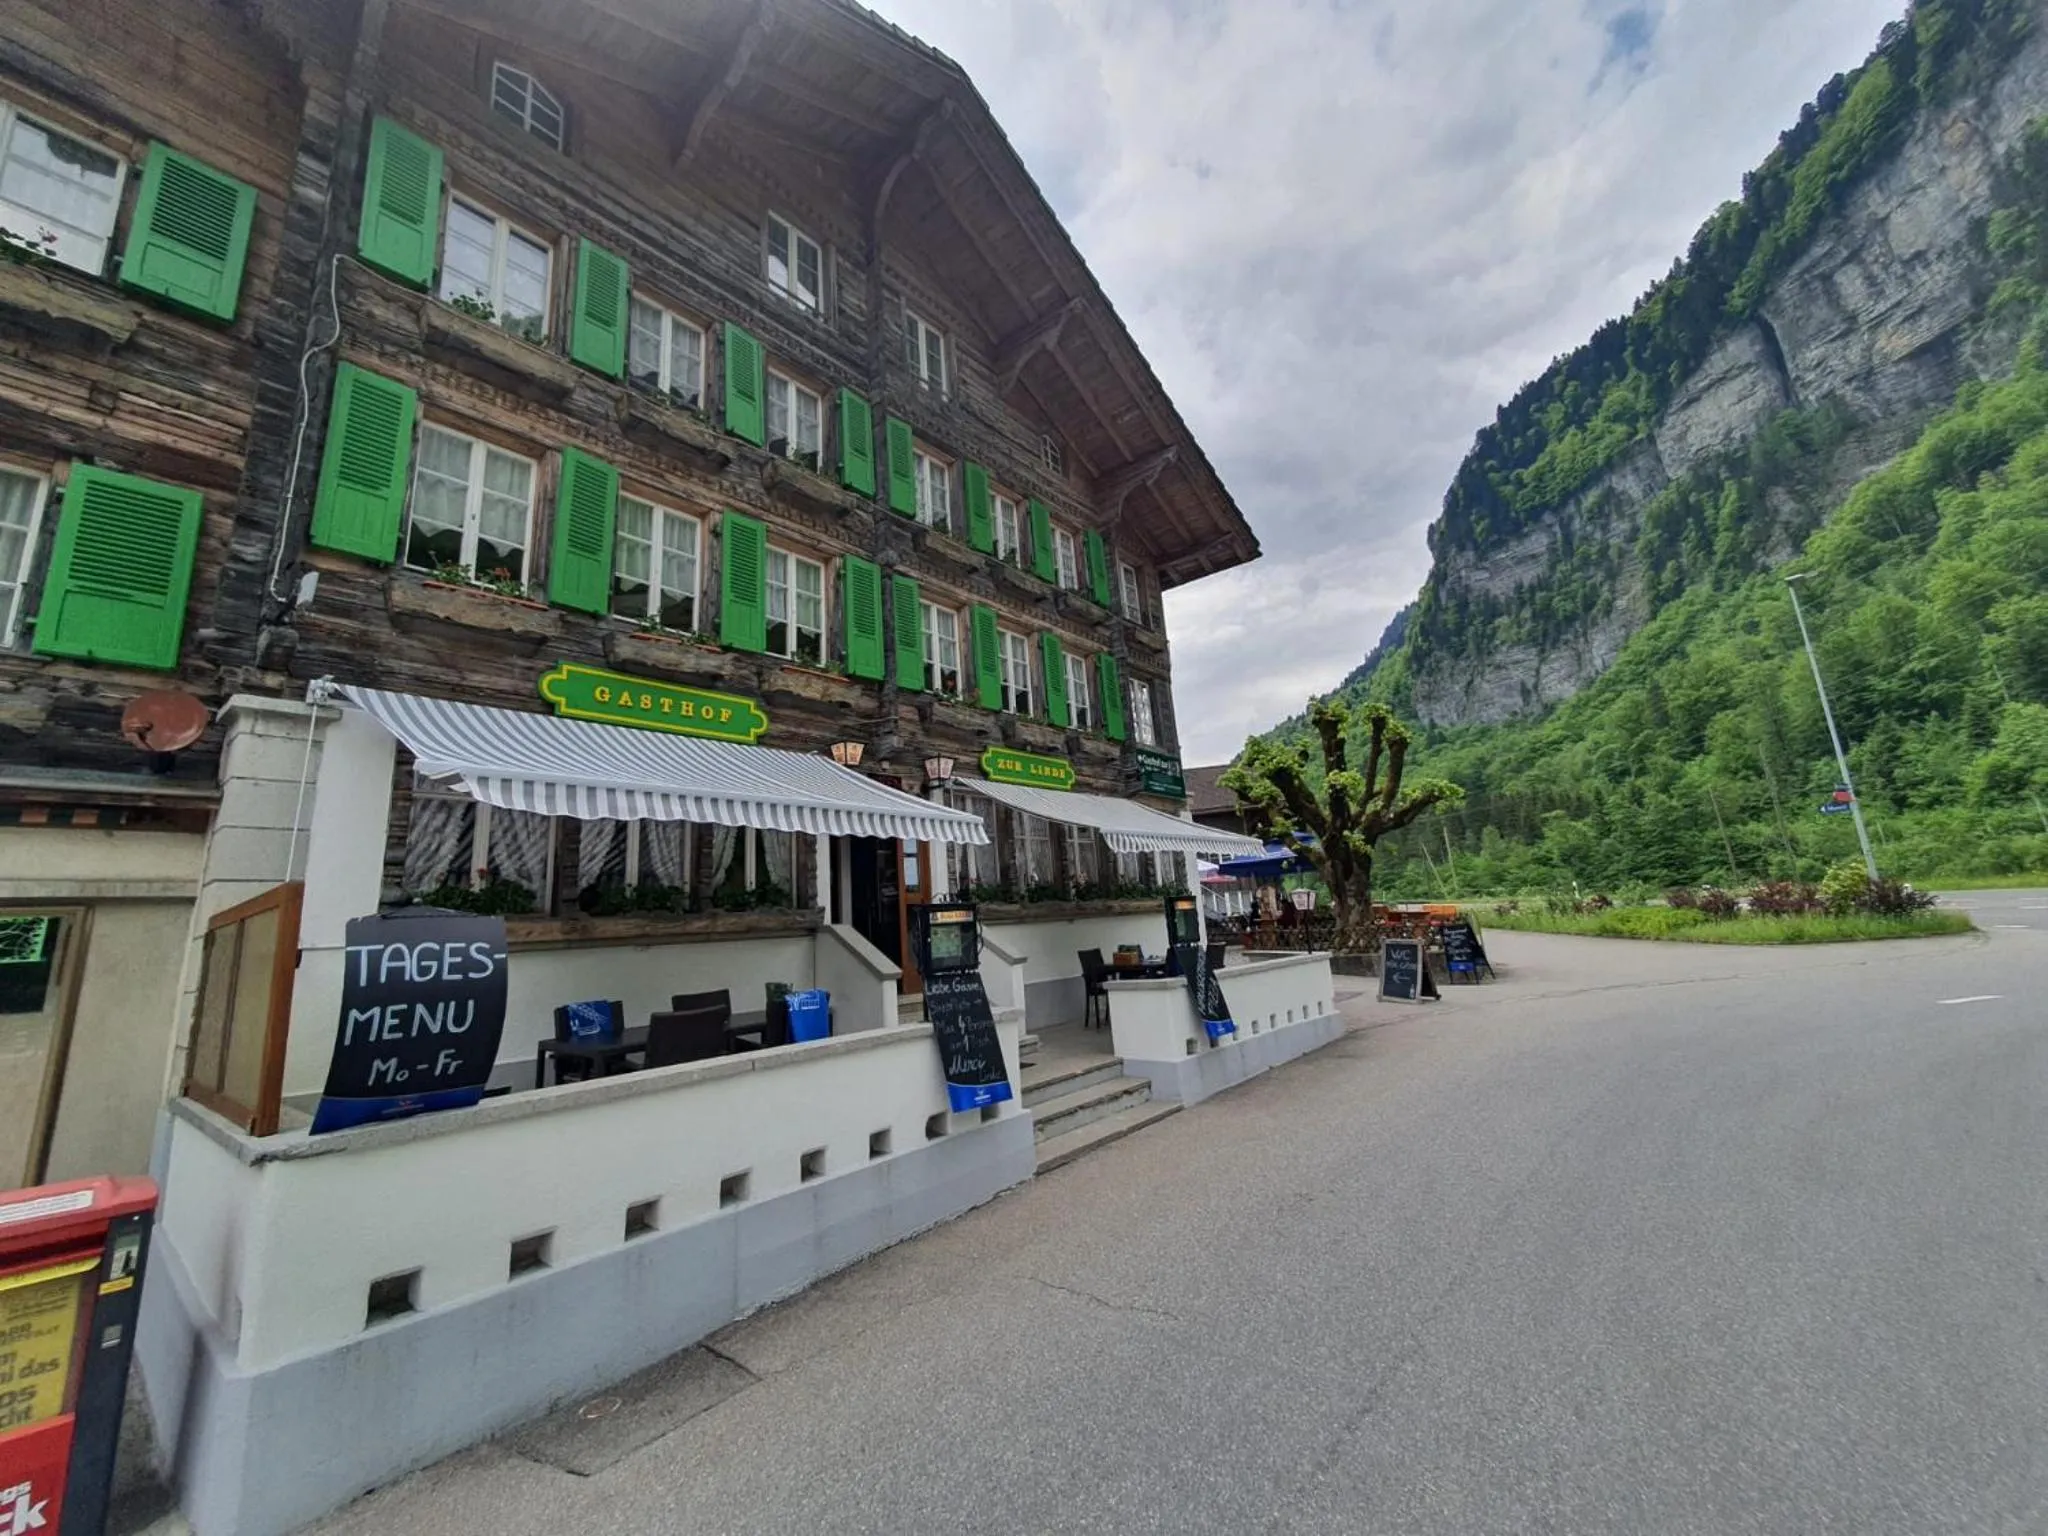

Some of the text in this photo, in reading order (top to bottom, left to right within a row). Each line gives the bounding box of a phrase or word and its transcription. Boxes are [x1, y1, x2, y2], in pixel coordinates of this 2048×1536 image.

[594, 686, 733, 723] GASTHOF
[997, 757, 1066, 779] ZUR LINDE
[346, 941, 506, 987] TAGES-
[1389, 948, 1411, 961] WC
[343, 998, 476, 1046] MENU
